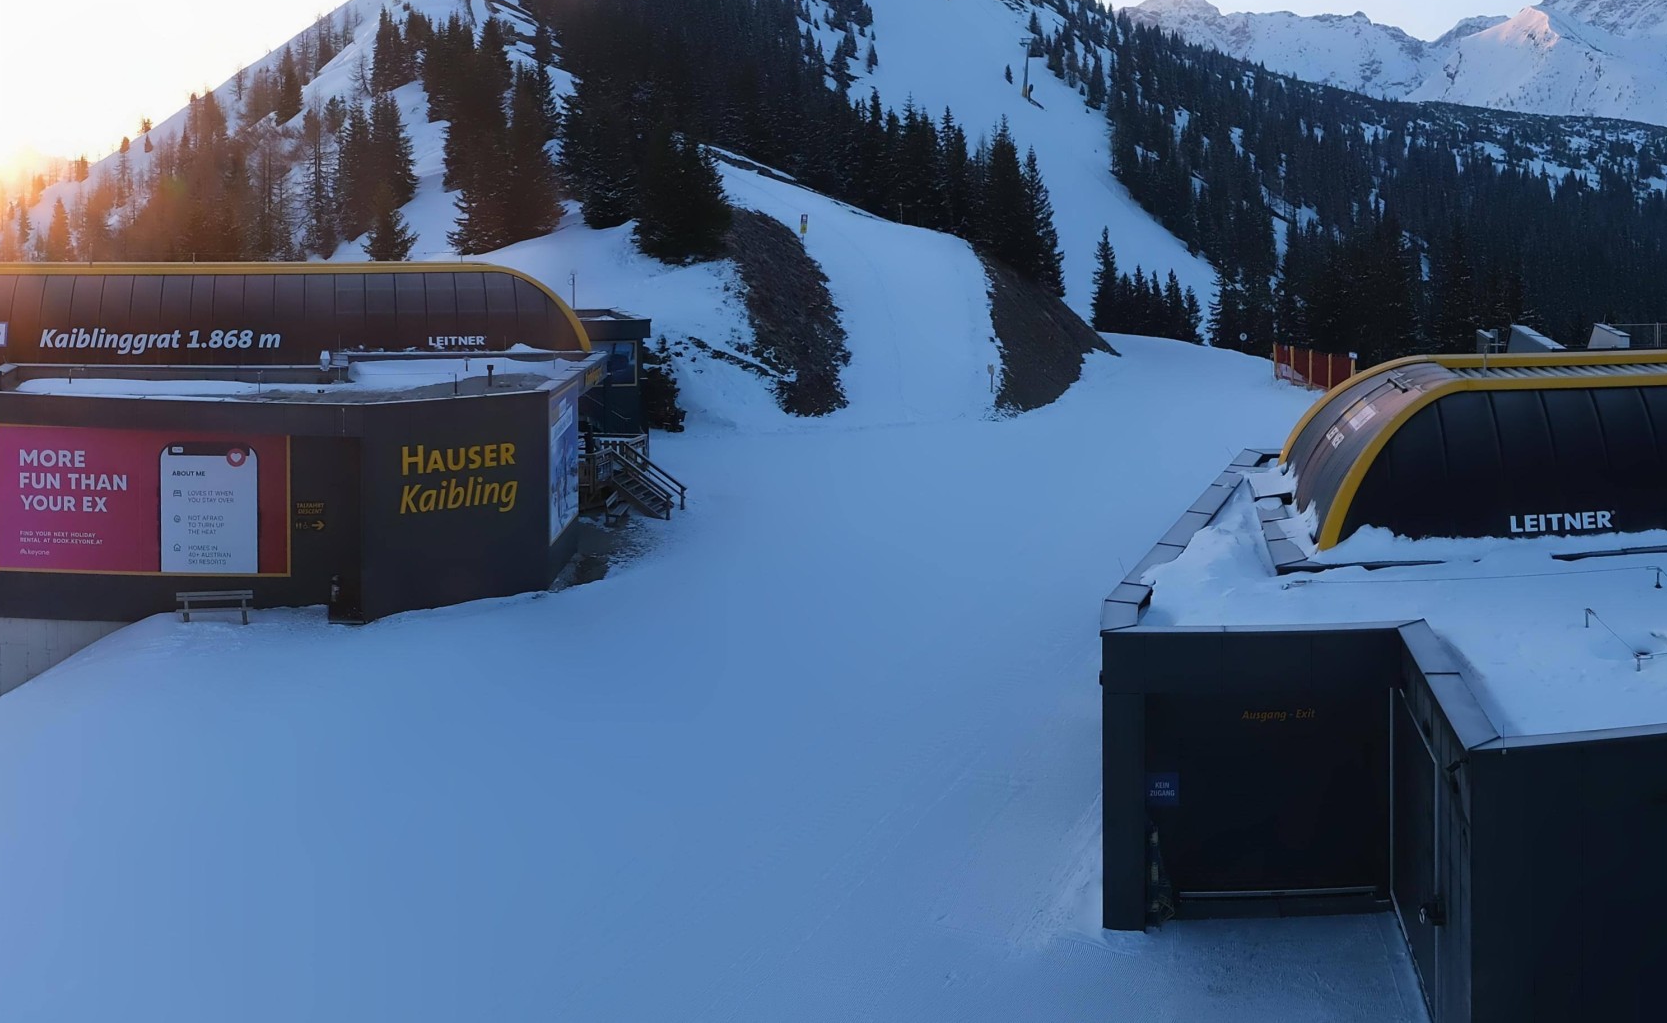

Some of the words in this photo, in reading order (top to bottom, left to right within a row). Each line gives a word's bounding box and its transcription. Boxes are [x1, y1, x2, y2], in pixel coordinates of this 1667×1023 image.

[39, 328, 181, 355] Kaiblinggrat
[187, 329, 253, 349] 1.868
[259, 333, 280, 349] m
[429, 335, 485, 346] LEITNER
[19, 449, 86, 468] MORE
[401, 442, 516, 476] HAUSER
[19, 472, 61, 490] FUN
[68, 473, 127, 491] THAN
[20, 495, 76, 512] YOUR
[83, 496, 108, 513] EX
[400, 476, 518, 514] Kaibling
[1510, 510, 1613, 533] LEITNER
[27, 548, 50, 556] keyone
[1242, 709, 1287, 722] Ausgang
[1295, 708, 1315, 719] Exit
